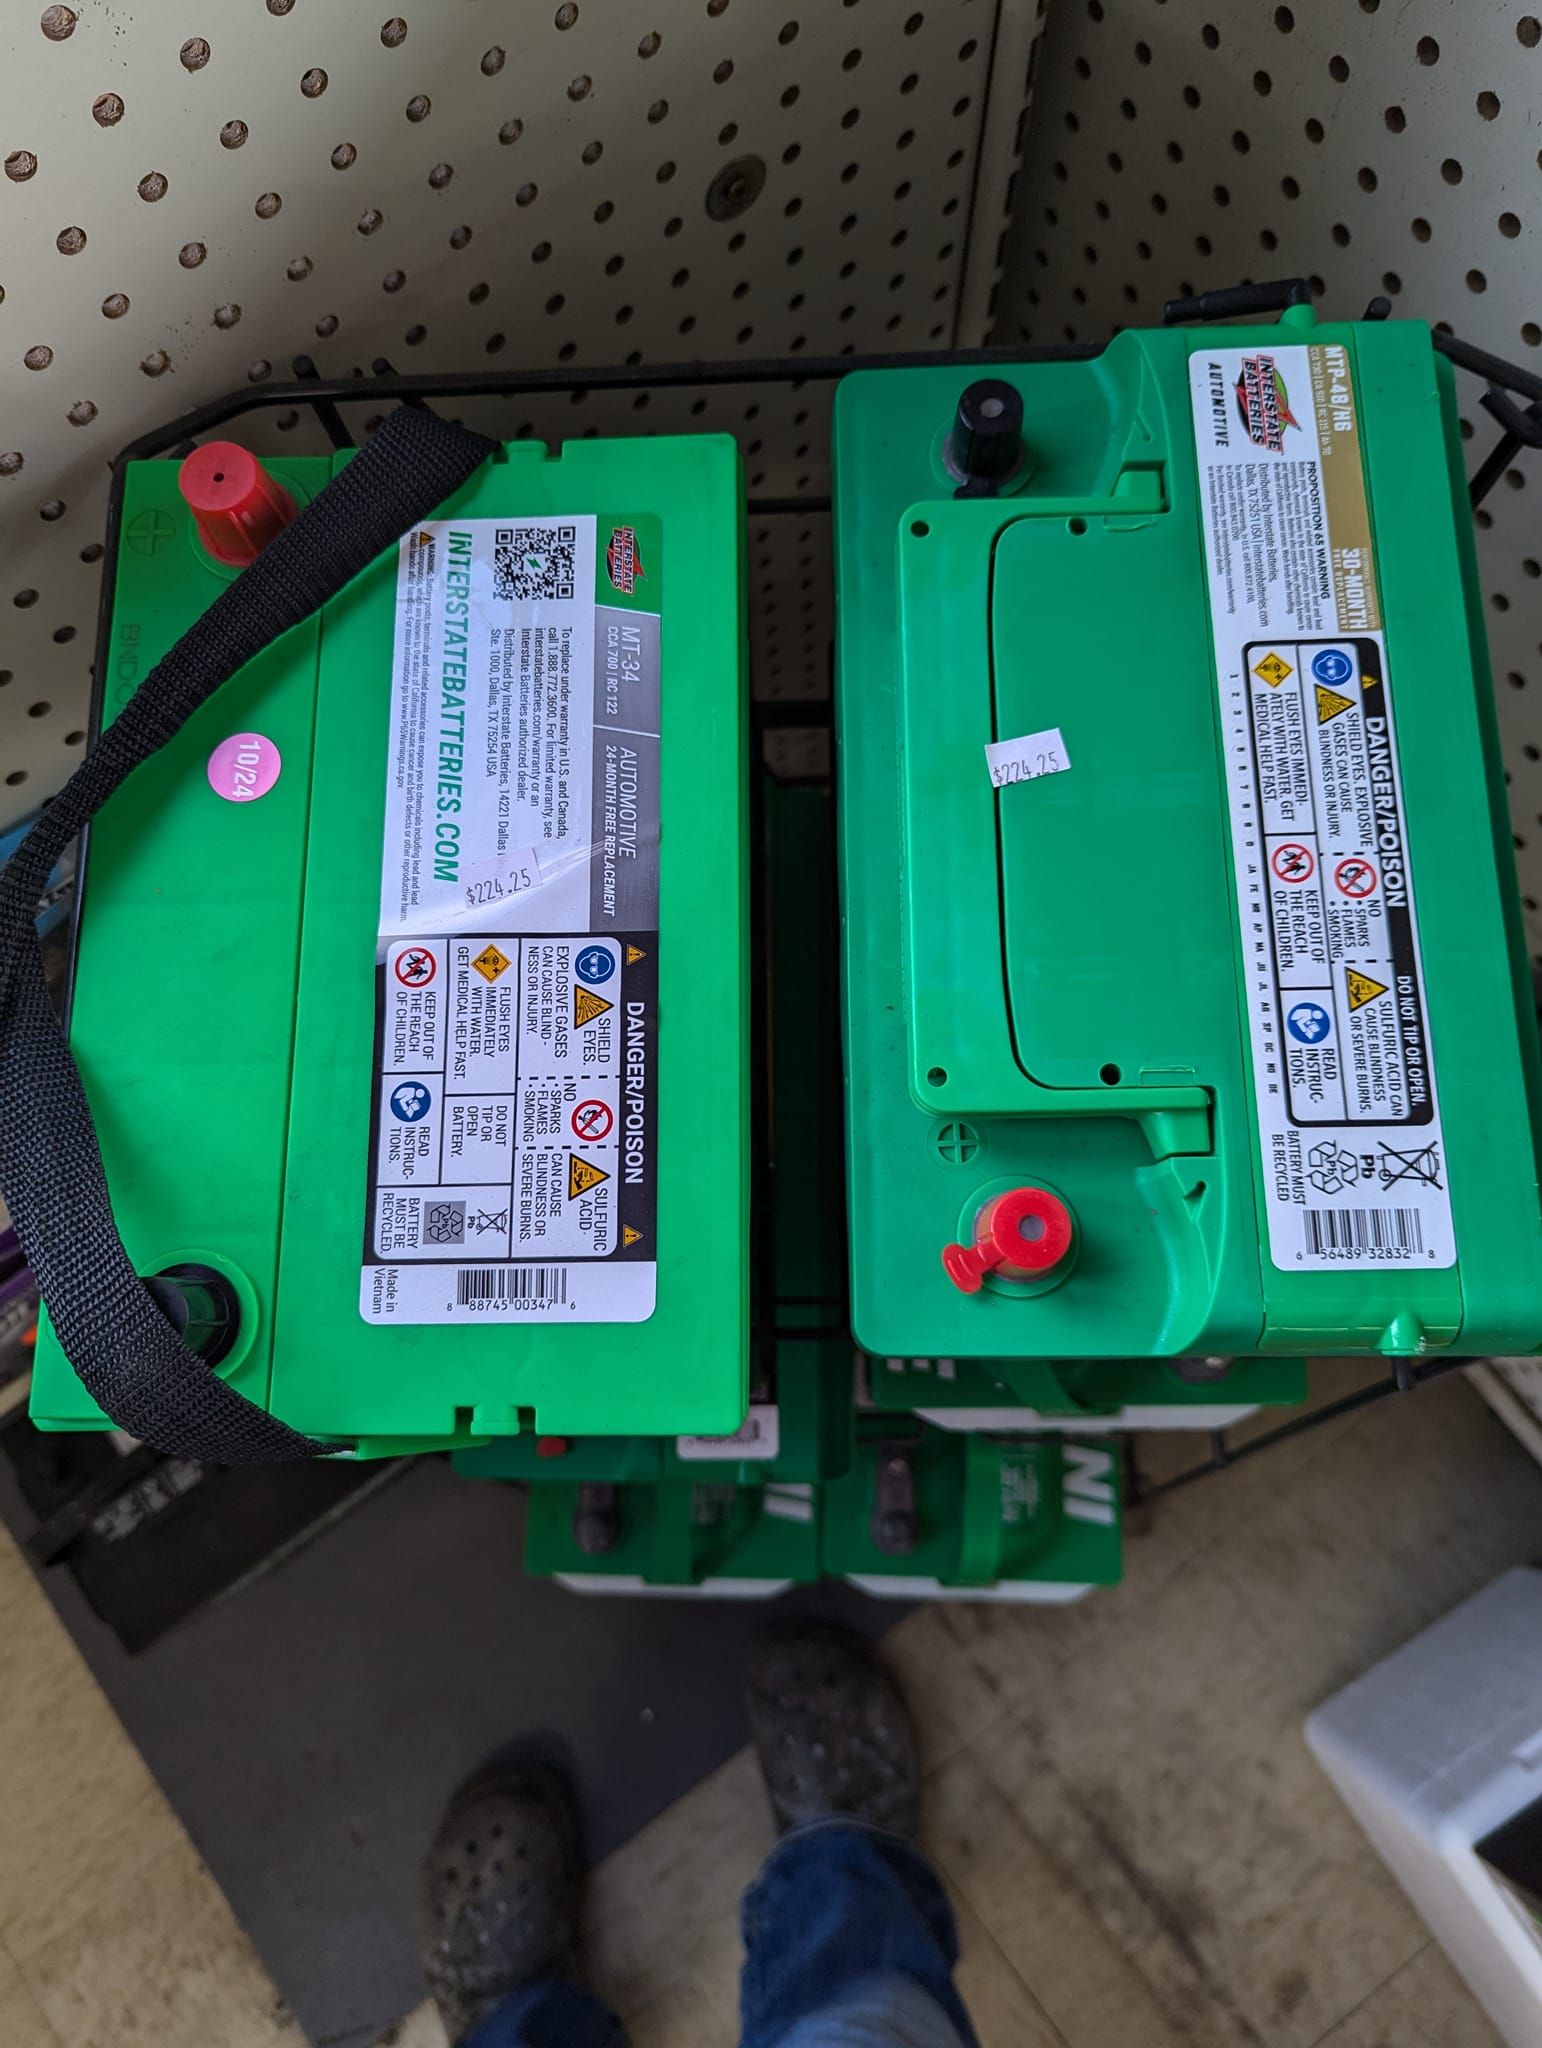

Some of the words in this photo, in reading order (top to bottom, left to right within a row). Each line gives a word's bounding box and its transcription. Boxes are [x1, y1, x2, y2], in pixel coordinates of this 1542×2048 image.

[1208, 362, 1229, 447] AUTOMOTIVE
[1245, 361, 1265, 444] BATTERIES
[1261, 357, 1282, 450] INTERSTATE
[1325, 347, 1352, 431] MTP-48/H6
[613, 528, 623, 590] BATTERIES
[623, 527, 634, 593] INTERSTATE
[1341, 548, 1368, 629] 30-MONTH
[490, 629, 501, 647] Ste.
[548, 627, 559, 643] call
[561, 626, 573, 638] To
[608, 626, 619, 647] CCA
[488, 650, 501, 675] 1000,
[503, 628, 515, 679] Distributed
[520, 628, 532, 673] Interstate
[558, 640, 572, 674] replace
[607, 650, 618, 669] 700
[621, 626, 640, 682] MT-34
[487, 677, 500, 708] Dallas,
[500, 681, 514, 693] by
[519, 675, 531, 717] Batteries
[546, 646, 558, 721] 1.888.772.3600.
[556, 675, 572, 704] under
[607, 678, 618, 693] RC
[434, 531, 472, 882] INTERSTATEBATTERIES.COM
[488, 709, 499, 723] TX
[501, 695, 513, 740] Interstate
[529, 628, 545, 781] interstatebatteries.com/warranty
[606, 696, 618, 714] 122
[1255, 694, 1271, 743] MEDICAL
[1269, 693, 1285, 723] ATELY
[1285, 692, 1300, 726] FLUSH
[487, 724, 499, 754] 75254
[546, 723, 557, 739] For
[555, 703, 570, 746] warranty
[1273, 725, 1288, 754] WITH
[1332, 722, 1348, 757] GASES
[1346, 712, 1362, 752] SHIELD
[518, 718, 530, 768] authorized
[545, 741, 556, 773] limited
[559, 748, 570, 757] in
[1259, 745, 1274, 773] HELP
[1288, 730, 1303, 755] EYES
[1318, 729, 1334, 782] BLINDNESS
[233, 740, 261, 797] 10/24
[486, 756, 498, 778] USA
[498, 742, 512, 787] Batteries,
[558, 759, 569, 778] U.S.
[605, 745, 617, 804] 24-MONTH
[993, 751, 1060, 785] $224.25
[1276, 756, 1292, 798] WATER.
[1336, 759, 1349, 779] CAN
[1351, 755, 1366, 784] EYES.
[498, 789, 510, 817] 14221
[517, 770, 530, 802] dealer.
[530, 794, 539, 807] an
[531, 782, 540, 793] or
[541, 775, 554, 819] warranty,
[558, 780, 570, 799] and
[619, 747, 637, 859] AUTOMOTIVE
[1262, 775, 1276, 803] FAST.
[1324, 784, 1336, 798] OR
[1338, 781, 1352, 812] CAUSE
[556, 800, 569, 839] Canada,
[605, 806, 616, 833] FREE
[1280, 800, 1295, 821] GET
[1326, 800, 1340, 838] INJURY.
[1355, 787, 1373, 846] EXPLOSIVE
[1366, 718, 1405, 907] DANGER/POISON
[497, 821, 509, 851] Dallas
[543, 821, 552, 838] see
[466, 868, 531, 905] $224.25
[603, 835, 616, 917] REPLACEMENT
[1368, 900, 1382, 917] NO
[1327, 909, 1344, 958] SMOKING
[1342, 909, 1356, 948] FLAMES
[1355, 909, 1370, 947] SPARKS
[457, 946, 469, 968] GET
[527, 946, 539, 974] NESS
[542, 946, 554, 967] CAN
[456, 970, 469, 1018] MEDICAL
[527, 976, 539, 991] OR
[541, 970, 553, 1005] CAUSE
[555, 946, 569, 1013] EXPLOSIVE
[1397, 976, 1412, 994] DO
[396, 991, 408, 1006] OF
[410, 991, 422, 1013] THE
[424, 991, 436, 1019] KEEP
[470, 986, 483, 1014] WITH
[499, 987, 511, 1022] FLUSH
[526, 994, 538, 1035] INJURY.
[1400, 997, 1416, 1022] NOT
[393, 1008, 407, 1066] CHILDREN.
[408, 1016, 421, 1052] REACH
[423, 1021, 435, 1044] OUT
[454, 1020, 468, 1049] HELP
[469, 1017, 482, 1057] WATER.
[484, 986, 497, 1058] IMMEDIATELY
[498, 1024, 510, 1052] EYES
[554, 1016, 568, 1058] GASES
[1350, 1016, 1362, 1031] OR
[1364, 1008, 1379, 1040] CAUSE
[1380, 1001, 1399, 1059] SULFURIC
[1403, 1025, 1419, 1044] TIP
[422, 1046, 434, 1060] OF
[583, 1030, 596, 1065] EYES.
[597, 1018, 611, 1063] SHIELD
[1352, 1033, 1367, 1071] SEVERE
[1405, 1047, 1421, 1065] OR
[454, 1051, 466, 1080] FAST.
[1368, 1043, 1386, 1101] BLINDNESS
[1385, 1062, 1401, 1091] ACID
[563, 1083, 576, 1101] NO
[625, 1002, 645, 1183] DANGER/POISON
[1356, 1074, 1371, 1113] BURNS.
[1408, 1068, 1426, 1106] OPEN.
[523, 1090, 536, 1142] SMOKING
[536, 1090, 549, 1135] FLAMES
[549, 1090, 562, 1134] SPARKS
[1389, 1094, 1403, 1116] CAN
[388, 1126, 402, 1164] TIONS.
[418, 1126, 430, 1157] READ
[1272, 1134, 1285, 1147] BE
[1288, 1130, 1303, 1174] BATTERY
[520, 1153, 534, 1198] SEVERE
[551, 1153, 563, 1176] CAN
[1273, 1150, 1290, 1201] RECYCLED
[535, 1154, 548, 1218] BLINDNESS
[549, 1179, 562, 1217] CAUSE
[1291, 1176, 1306, 1205] MUST
[380, 1193, 395, 1254] RECYCLED.
[394, 1198, 407, 1231] MUST
[407, 1198, 420, 1249] BATTERY
[519, 1200, 532, 1243] BURNS.
[534, 1220, 546, 1236] OR
[593, 1187, 608, 1251] SULFURIC
[393, 1233, 405, 1248] BE
[1320, 1248, 1361, 1260] 56489
[1369, 1248, 1411, 1259] 32832
[372, 1267, 386, 1314] Vietnam
[384, 1269, 399, 1300] Made
[386, 1302, 398, 1312] in
[470, 1301, 508, 1311] 88745
[515, 1300, 553, 1310] 00347
